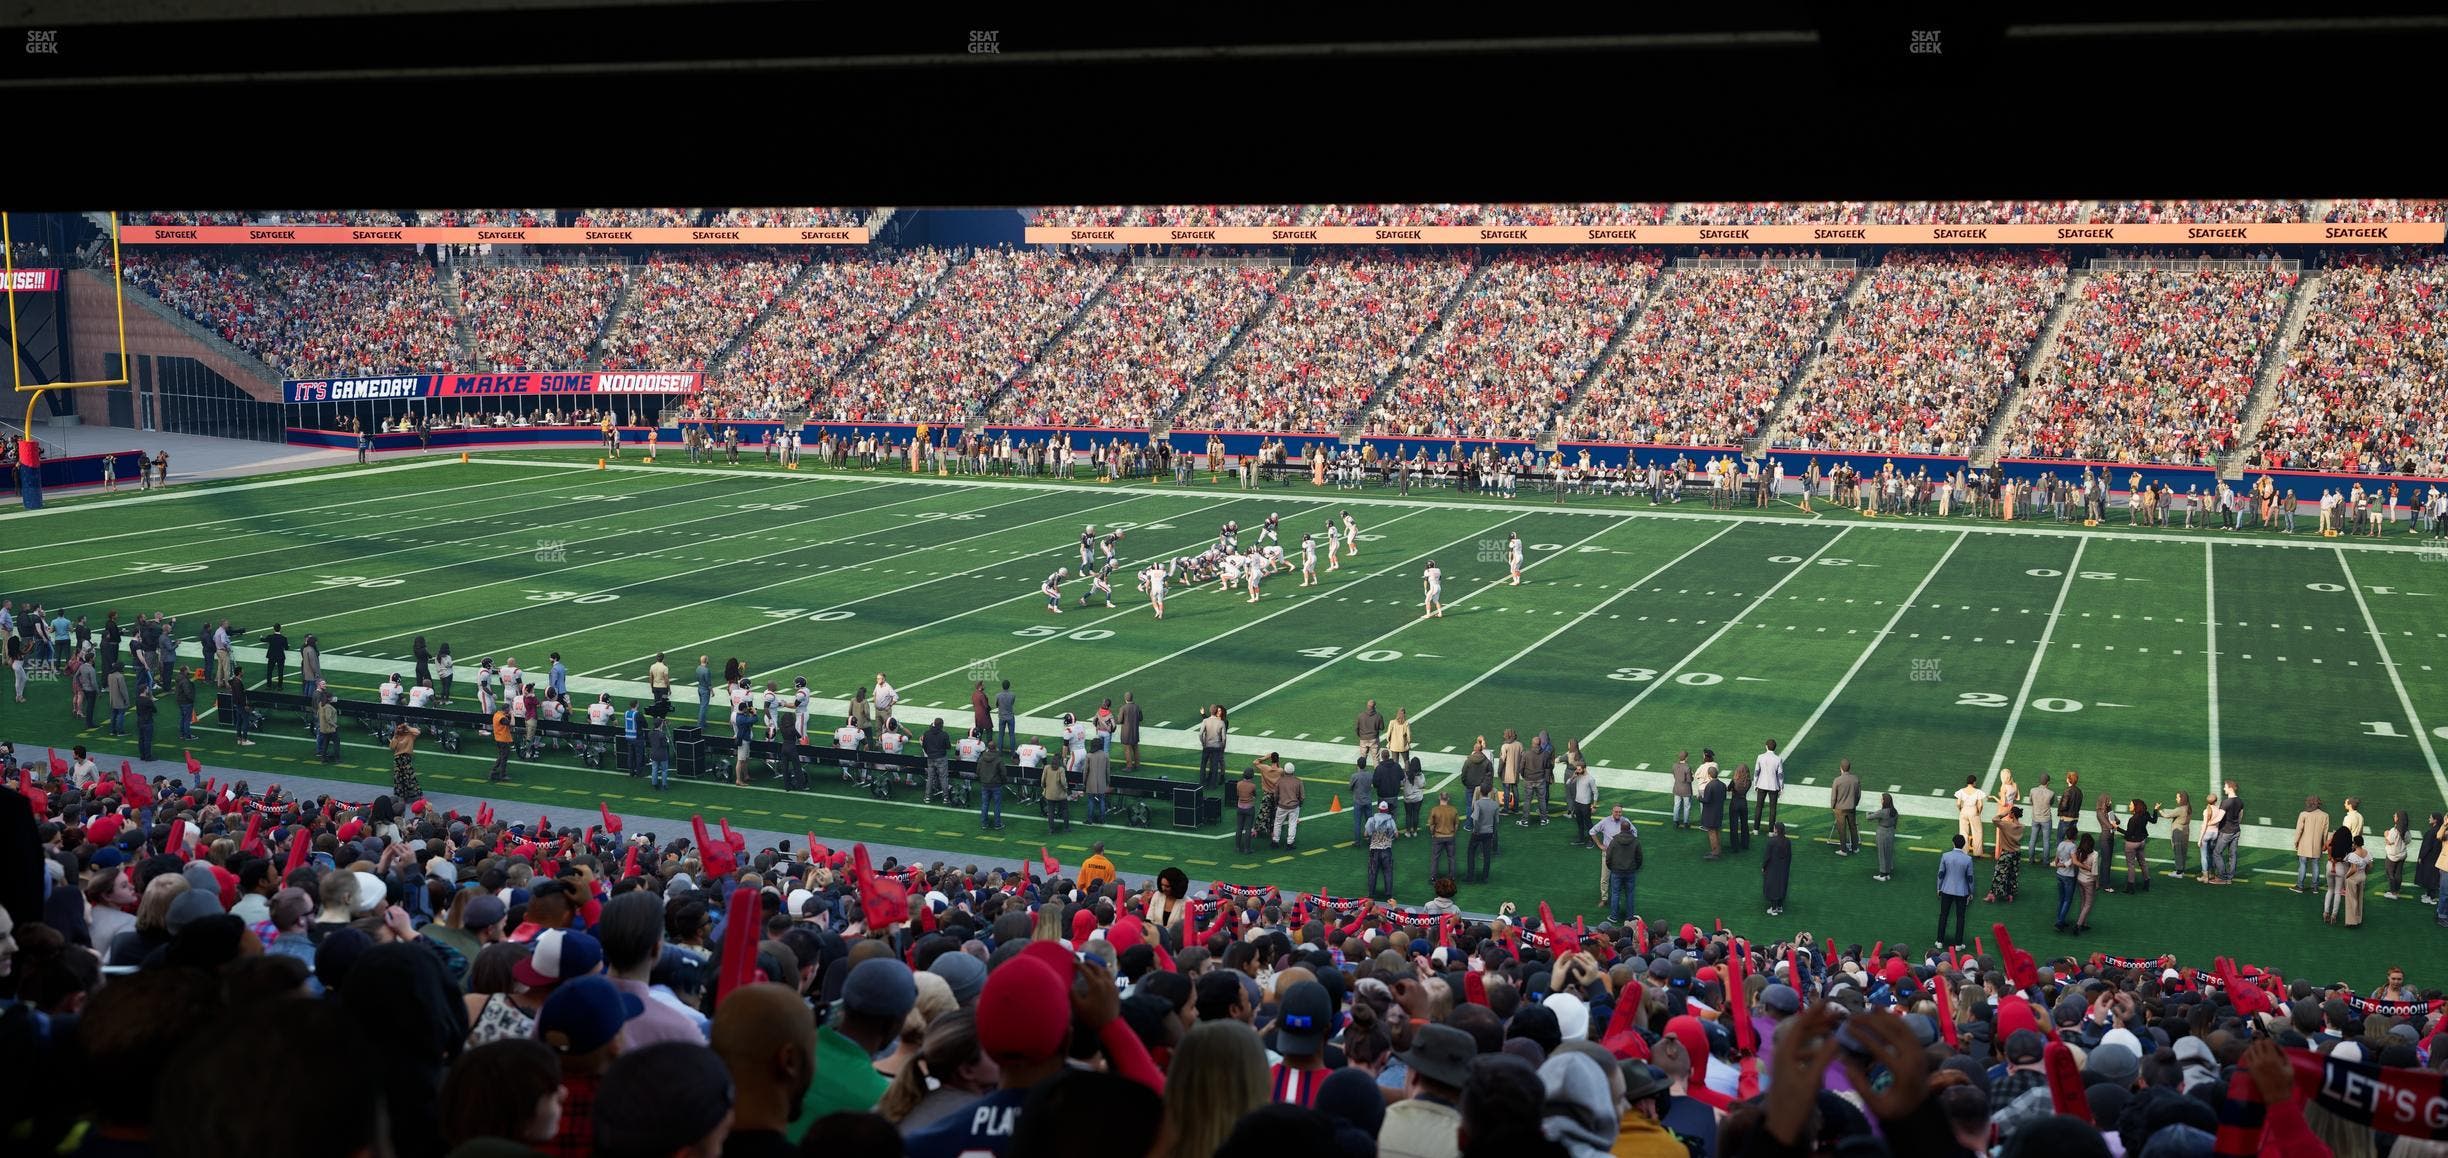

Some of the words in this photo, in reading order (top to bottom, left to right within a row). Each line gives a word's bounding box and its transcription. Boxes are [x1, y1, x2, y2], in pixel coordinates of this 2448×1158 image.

[295, 382, 327, 401] IT'S
[331, 378, 418, 400] GAMEDAY!
[454, 375, 530, 394] MAKE
[540, 375, 593, 393] SOME
[597, 374, 694, 393] NOOOOISE!!!
[2349, 997, 2375, 1012] LET'S
[2321, 1062, 2417, 1123] LET'S
